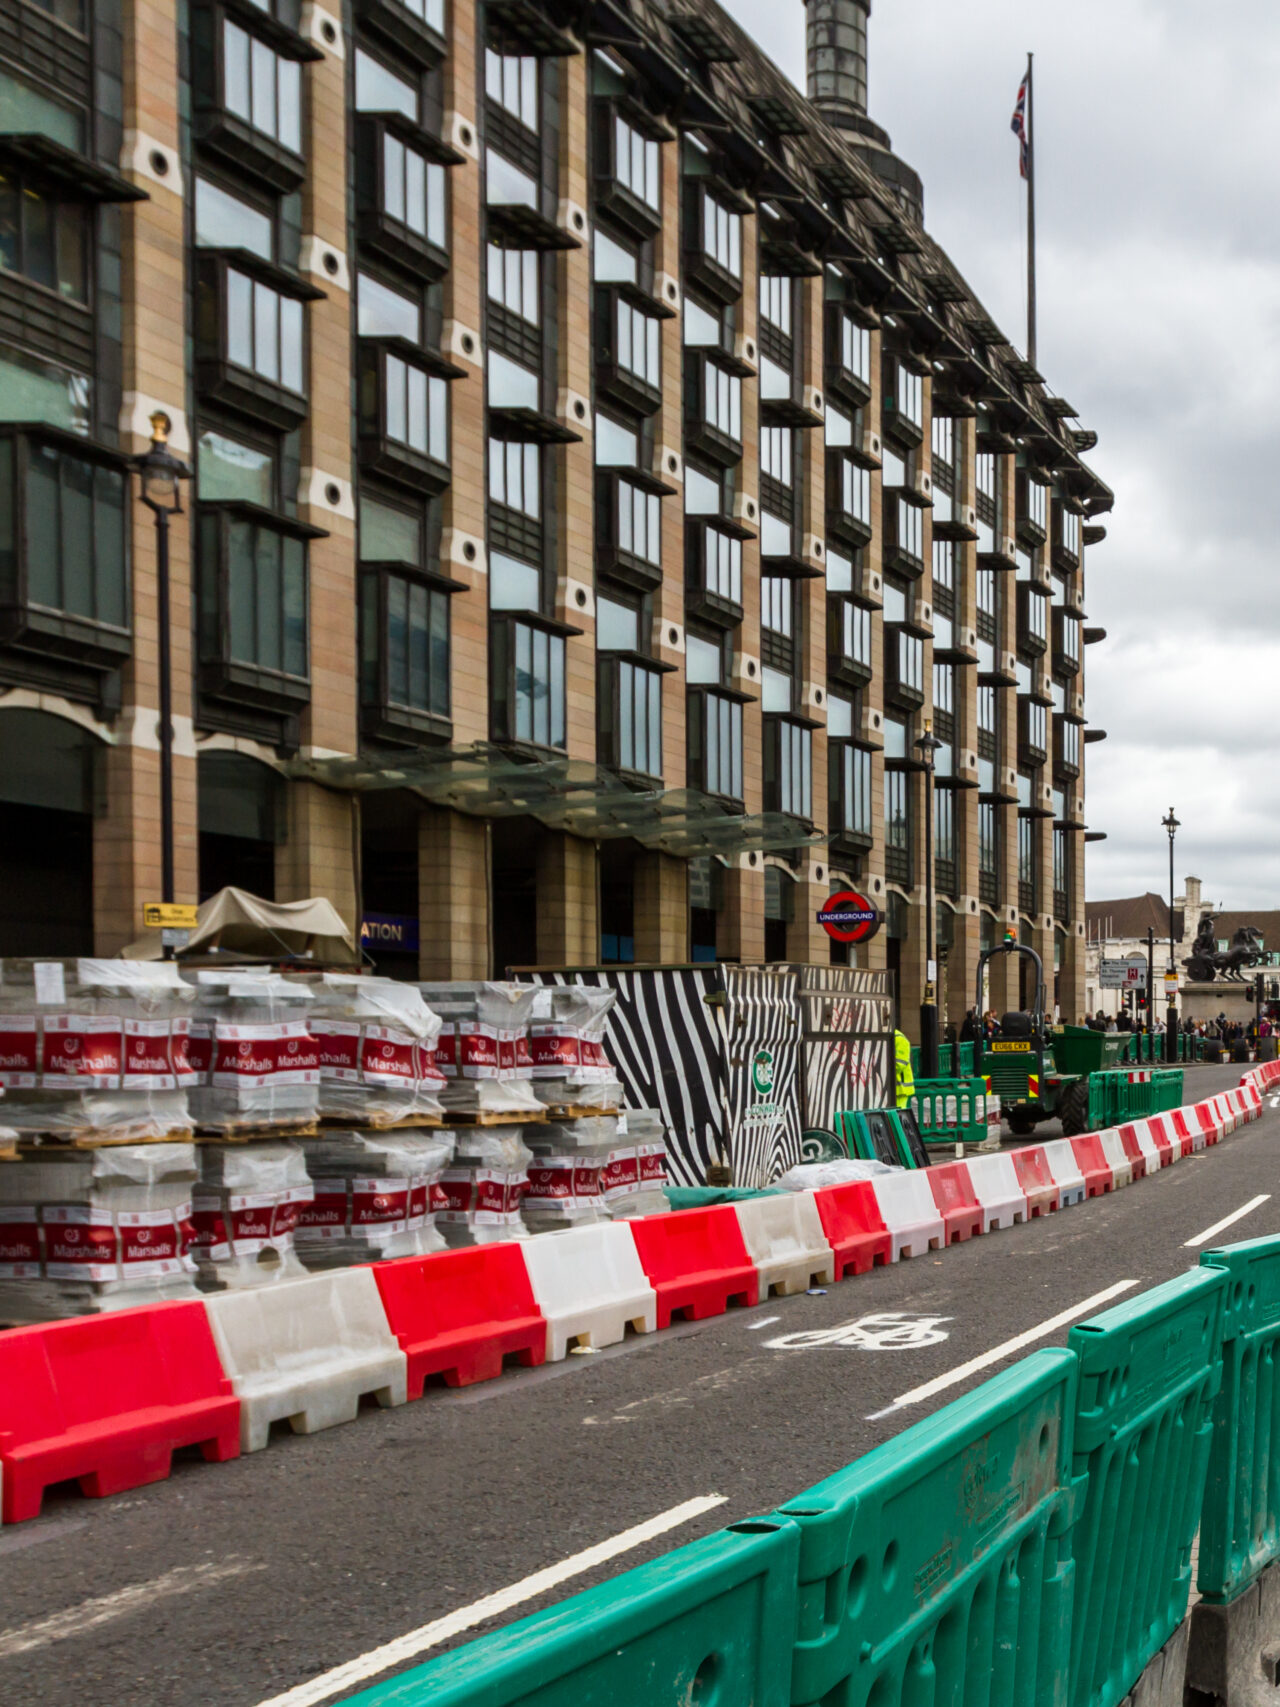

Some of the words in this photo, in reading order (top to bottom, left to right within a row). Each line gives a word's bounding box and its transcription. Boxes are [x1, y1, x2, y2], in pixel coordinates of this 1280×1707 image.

[820, 912, 874, 920] UNDERGROUND
[51, 1055, 118, 1070] Marshalls
[223, 1055, 272, 1071] Marshalls
[277, 1053, 317, 1067] Marshalls
[54, 1244, 111, 1259] Marshalls
